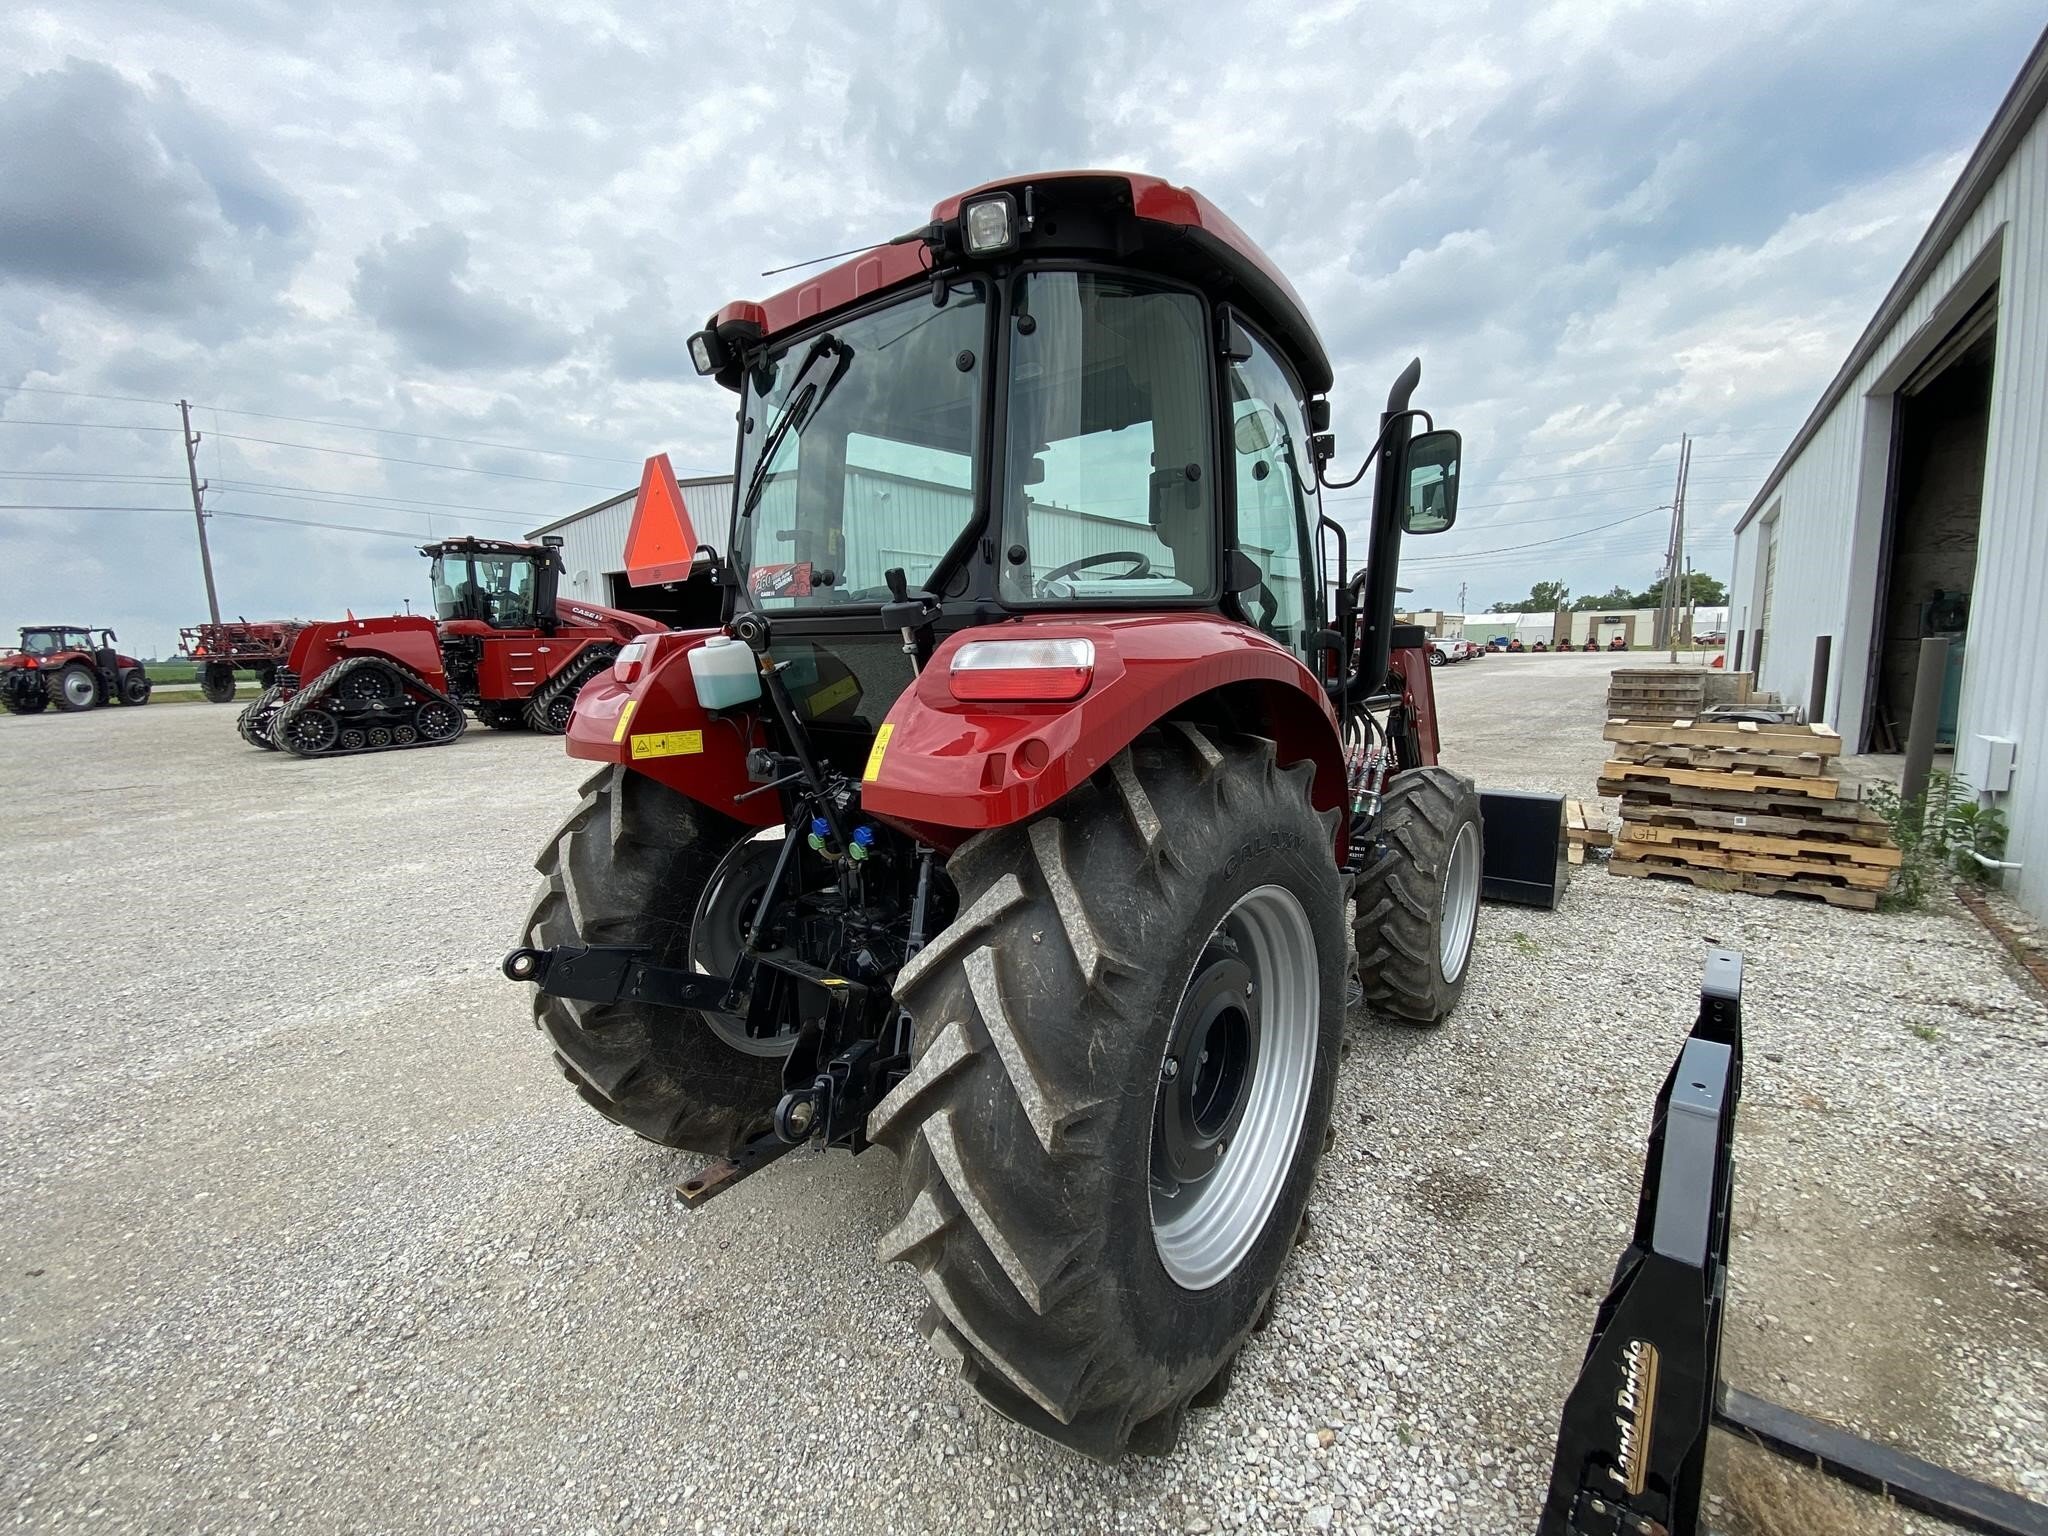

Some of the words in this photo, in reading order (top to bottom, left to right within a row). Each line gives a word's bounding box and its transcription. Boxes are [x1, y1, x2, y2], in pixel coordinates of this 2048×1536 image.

[754, 573, 772, 594] 260
[774, 574, 793, 590] COMBINE
[572, 607, 595, 618] CASE
[1633, 829, 1658, 841] GH
[1223, 831, 1305, 881] GALAXY
[1616, 1340, 1649, 1417] Pride
[1608, 1415, 1641, 1491] Land
